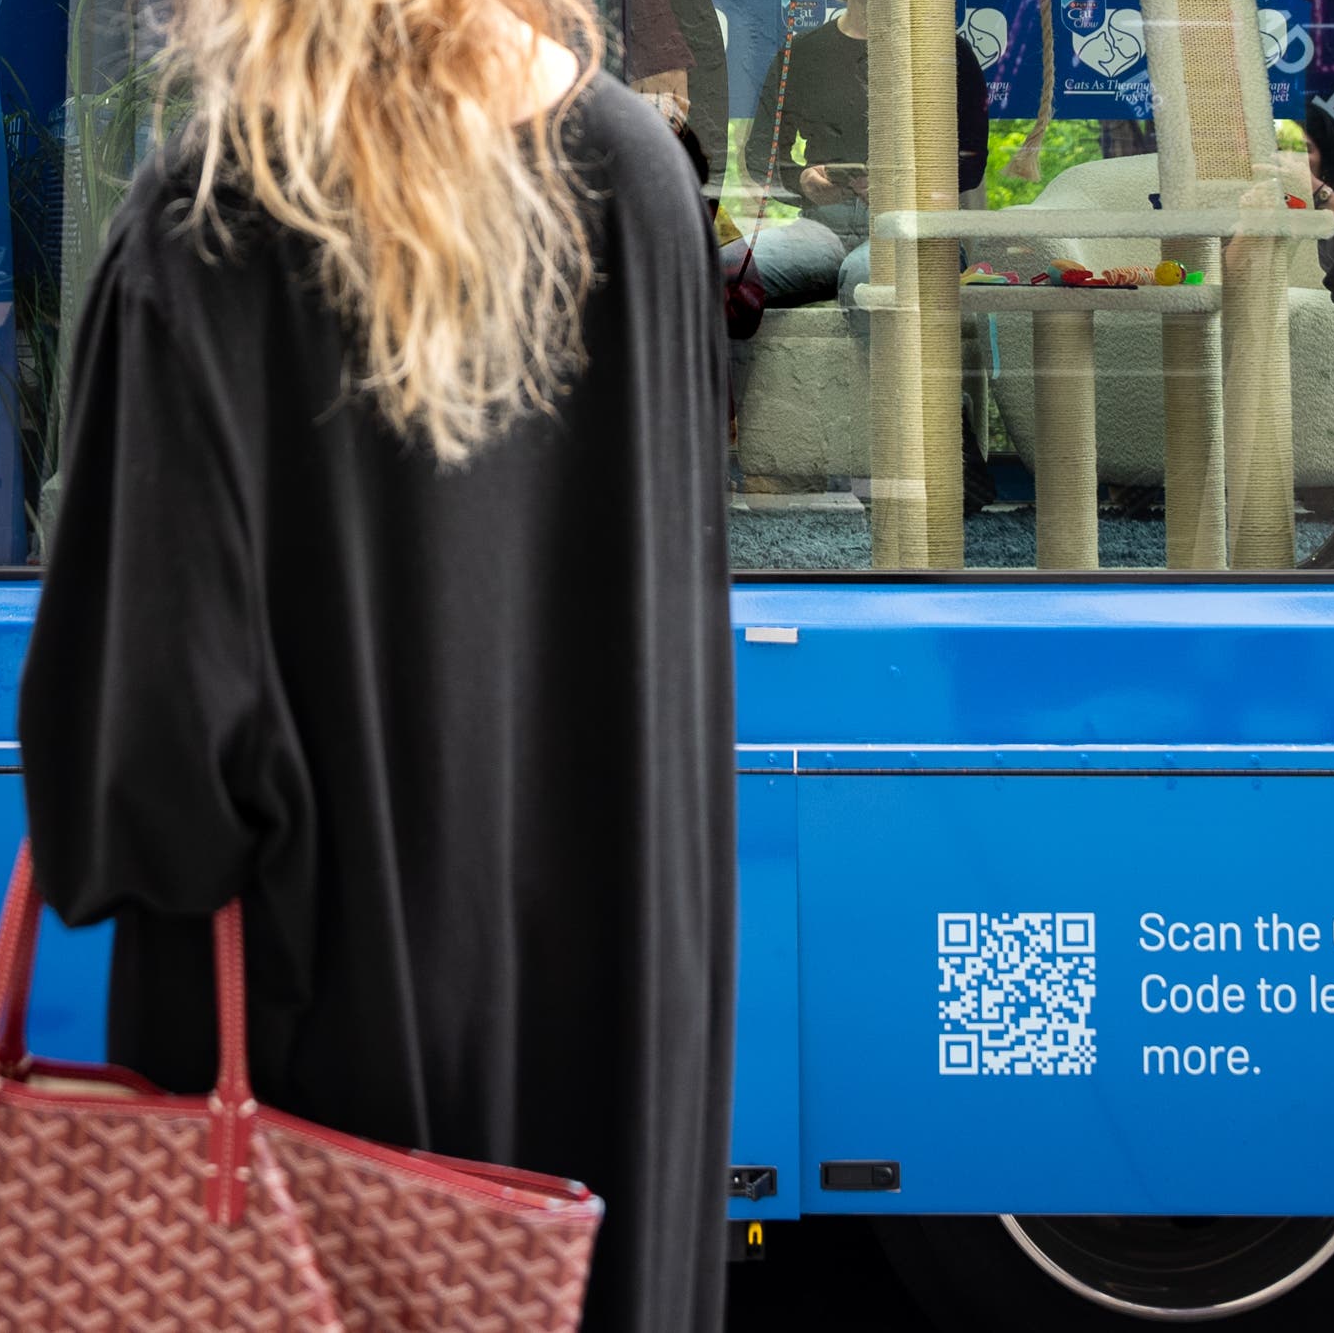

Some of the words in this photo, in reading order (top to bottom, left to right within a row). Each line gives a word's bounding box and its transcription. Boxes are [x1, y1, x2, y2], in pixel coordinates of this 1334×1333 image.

[1067, 8, 1093, 20] Cat
[1064, 78, 1090, 90] Cats
[1092, 79, 1105, 90] As
[1139, 913, 1242, 952] Scan
[1254, 913, 1321, 952] the
[1141, 974, 1246, 1013] Code
[1256, 978, 1297, 1013] to
[1143, 1045, 1261, 1075] more.
